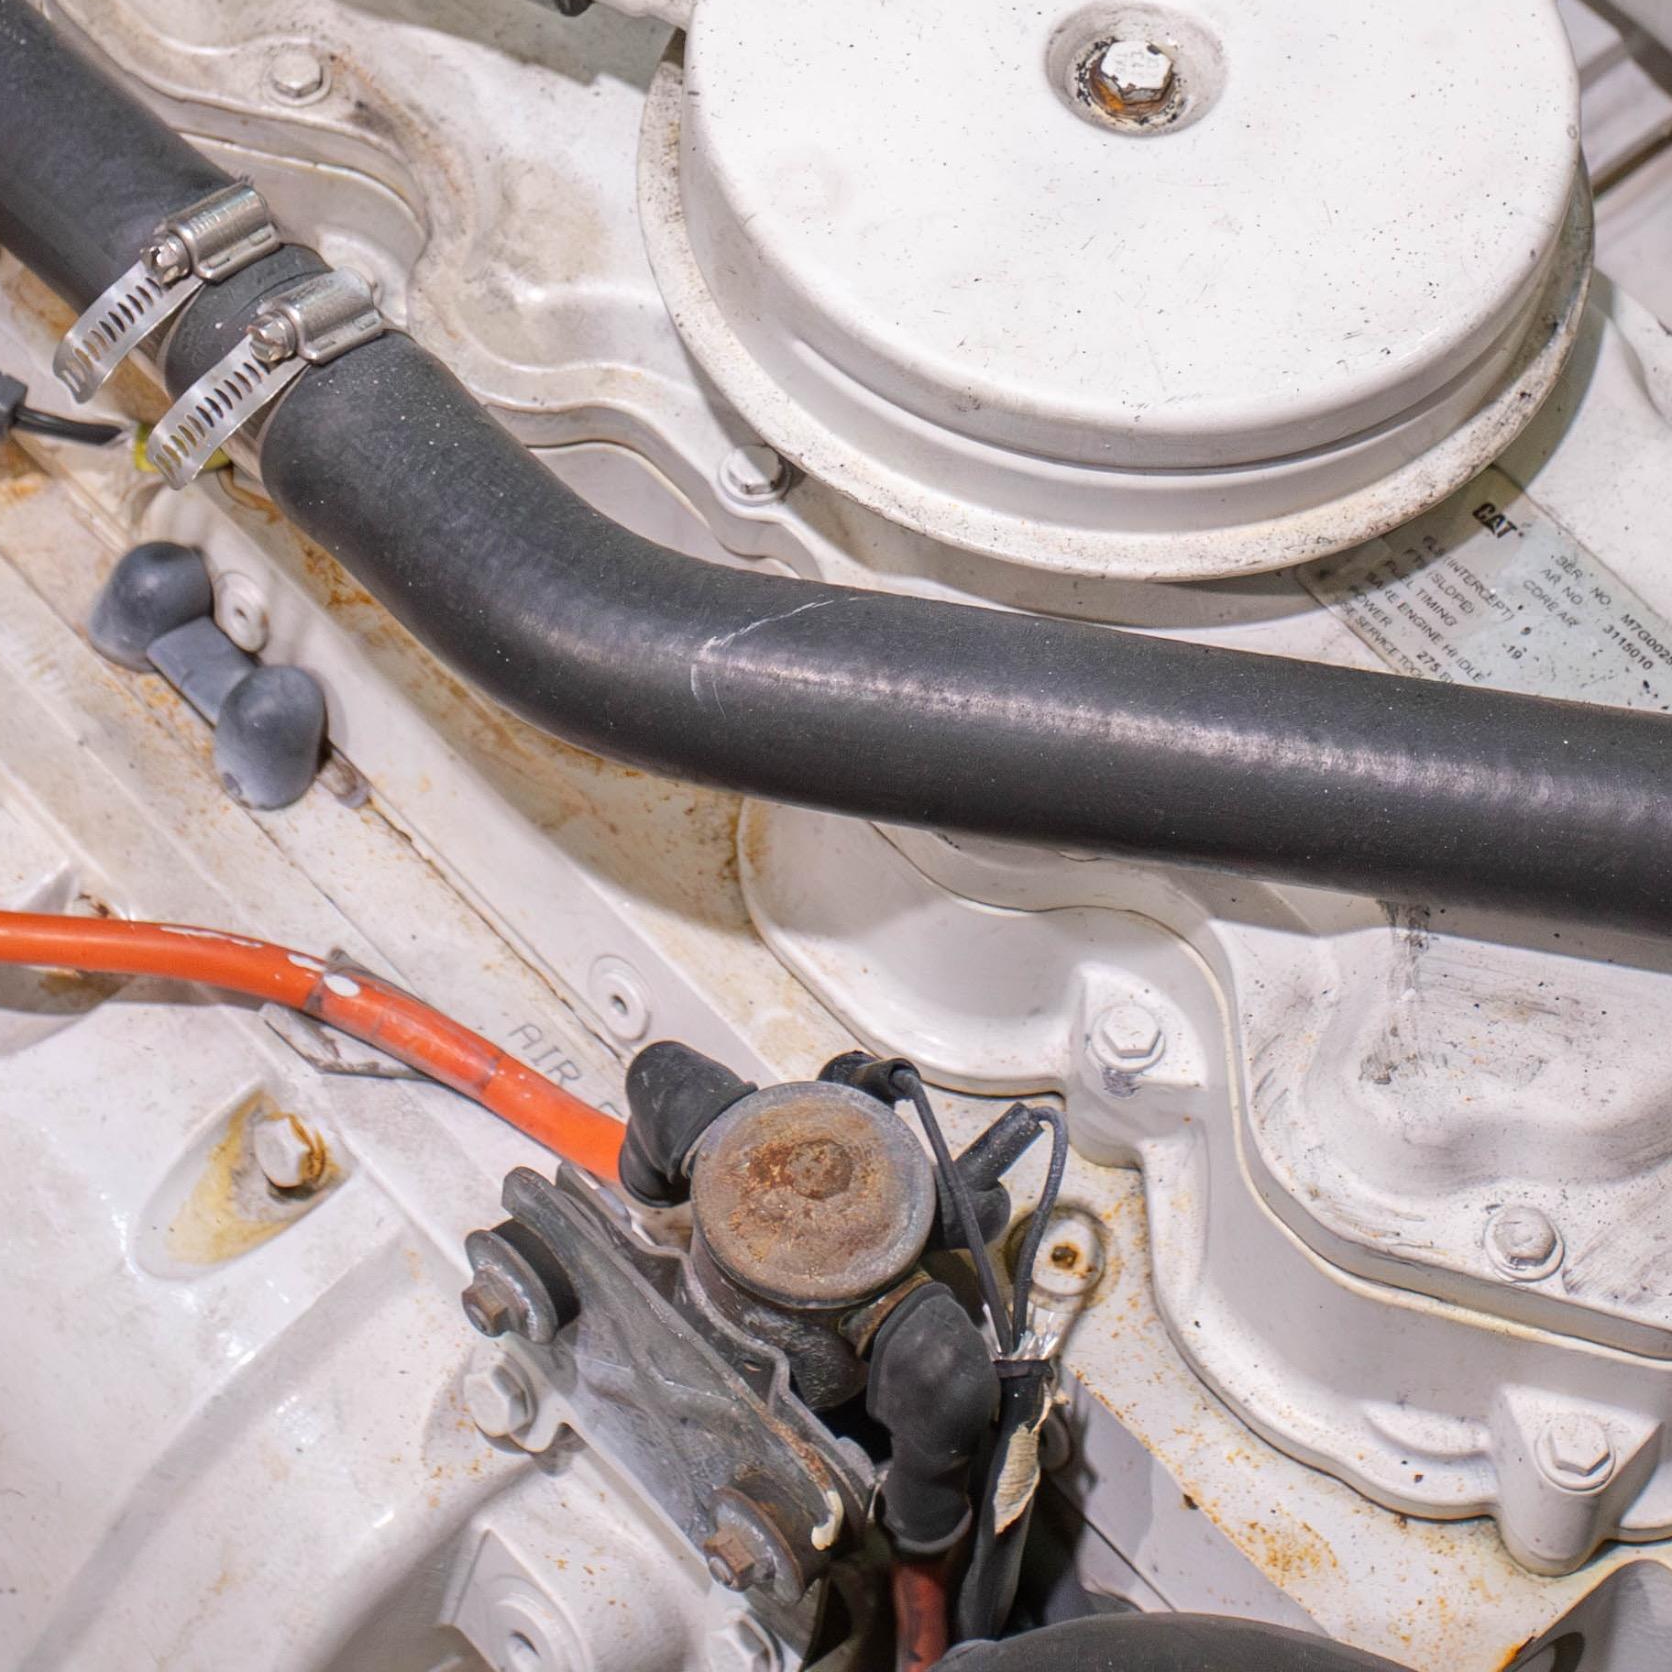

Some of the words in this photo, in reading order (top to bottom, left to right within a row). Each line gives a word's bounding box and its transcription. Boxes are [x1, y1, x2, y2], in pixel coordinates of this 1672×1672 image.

[1472, 502, 1518, 539] CAT
[1415, 588, 1459, 628] TIMING
[1427, 570, 1476, 616] (SLOPE)
[1443, 556, 1516, 623] (INTERCEPT)
[1523, 579, 1559, 613] CORE
[1348, 584, 1393, 628] POWER
[1416, 650, 1442, 673] 275
[1354, 615, 1398, 656] SERVICE
[1396, 601, 1445, 646] ENGINE
[1442, 643, 1459, 658] HI
[1456, 656, 1488, 682] IDLE
[1541, 567, 1563, 586] AR
[1602, 624, 1654, 671] 3115010
[508, 1023, 581, 1086] AIR
